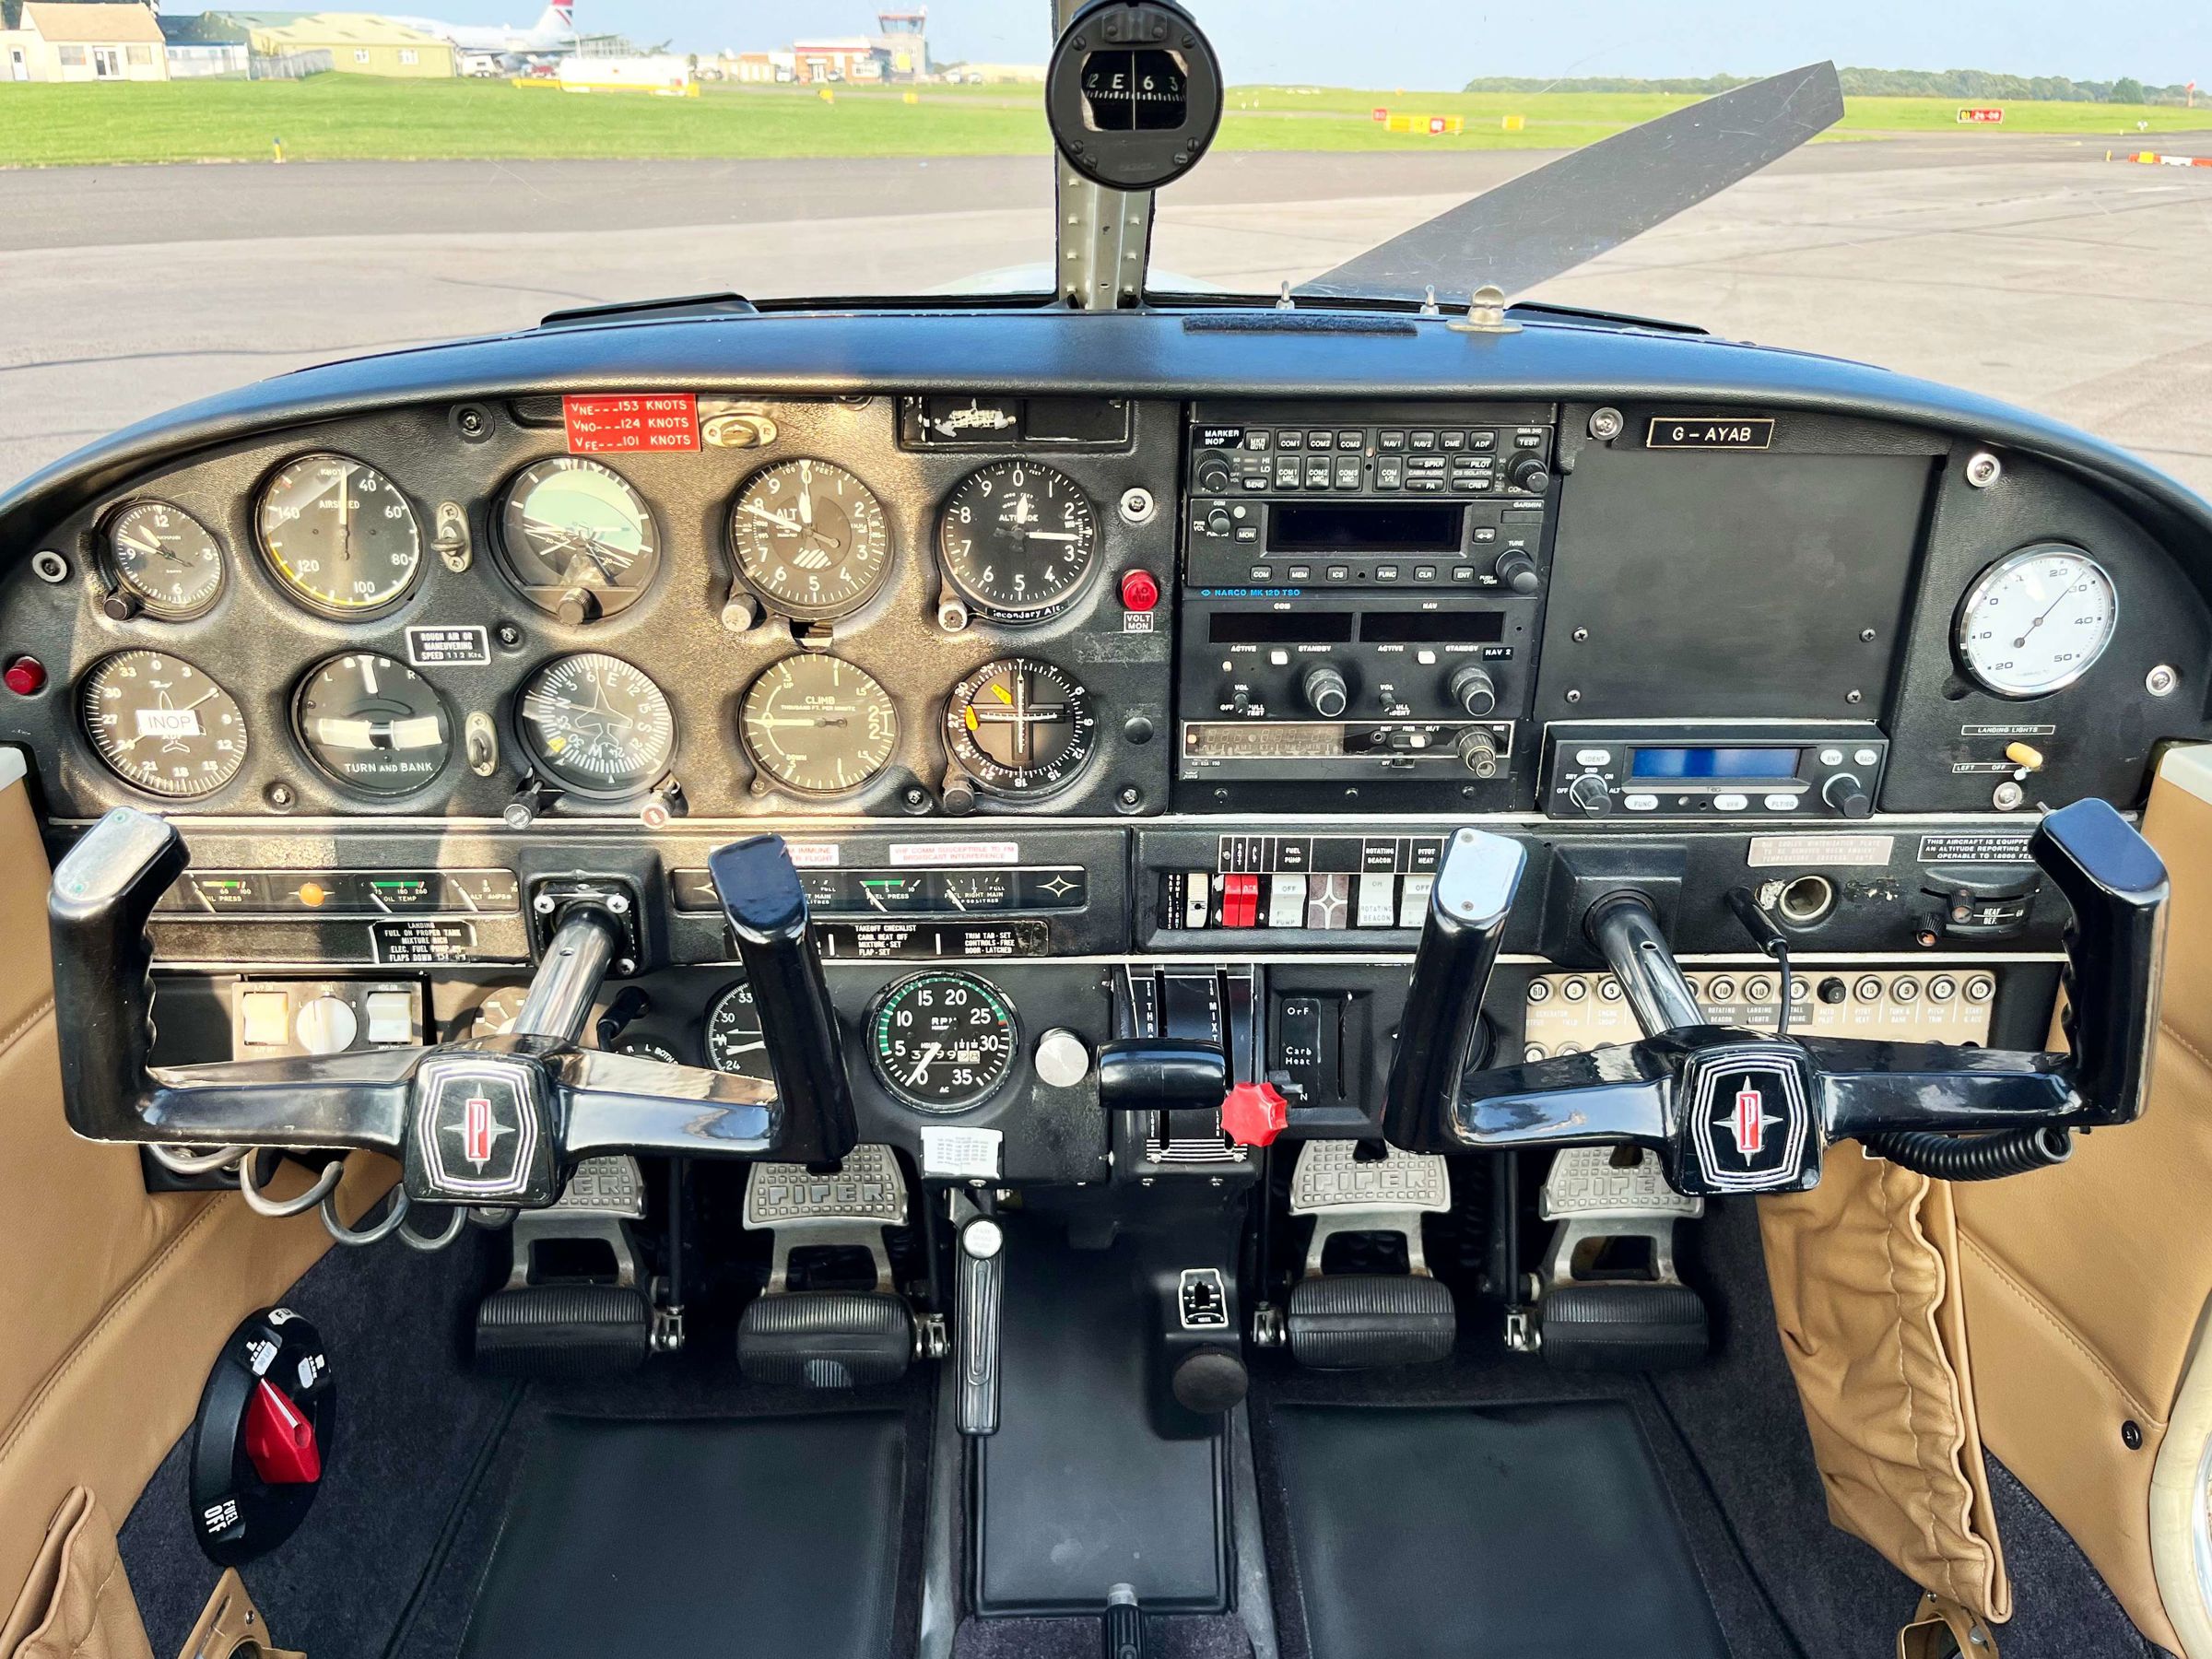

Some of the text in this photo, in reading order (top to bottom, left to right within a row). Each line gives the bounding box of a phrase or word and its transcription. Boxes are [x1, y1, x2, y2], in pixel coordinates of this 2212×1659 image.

[646, 400, 688, 410] KNOTS
[649, 418, 689, 428] KNOTS
[651, 435, 690, 445] KNOTS
[359, 480, 376, 491] 40
[769, 478, 780, 494] 9
[1013, 470, 1024, 487] 0
[982, 480, 992, 497] 9
[278, 508, 300, 519] 140
[385, 507, 402, 518] 60
[854, 502, 865, 517] 2
[960, 507, 971, 523] 8
[1065, 502, 1074, 519] 2
[154, 515, 170, 527] 12
[857, 545, 867, 559] 3
[961, 540, 971, 557] 7
[1065, 546, 1075, 561] 3
[298, 560, 319, 571] 120
[392, 554, 408, 565] 80
[775, 567, 787, 581] 6
[840, 567, 852, 582] 4
[983, 566, 994, 582] 6
[1044, 566, 1055, 582] 4
[354, 582, 375, 594] 100
[809, 576, 819, 591] 5
[1014, 574, 1025, 592] 5
[420, 632, 473, 641] ROUGH AIR OR
[421, 652, 443, 660] SPEED
[120, 667, 136, 677] 33
[1995, 662, 2013, 670] 20
[806, 696, 835, 705] CLIMB
[868, 705, 879, 722] 2
[147, 715, 191, 729] INOP
[869, 724, 880, 739] 2
[345, 763, 376, 772] TURN
[401, 762, 432, 771] BANK
[738, 993, 753, 1003] 33
[918, 990, 934, 1006] 15
[945, 989, 967, 1005] 20
[721, 1013, 735, 1023] 30
[897, 1011, 912, 1027] 10
[970, 1008, 991, 1024] 25
[895, 1041, 906, 1056] 5
[979, 1035, 998, 1051] 30
[654, 1046, 674, 1064] BOTH
[1286, 1046, 1312, 1056] Carb
[725, 1060, 740, 1070] 24
[1286, 1057, 1311, 1065] Heat
[952, 1069, 972, 1085] 35
[1313, 1171, 1426, 1190] PIPER
[770, 1184, 884, 1204] PIPER
[204, 1504, 227, 1534] OFF
[223, 1499, 239, 1525] FUEL
